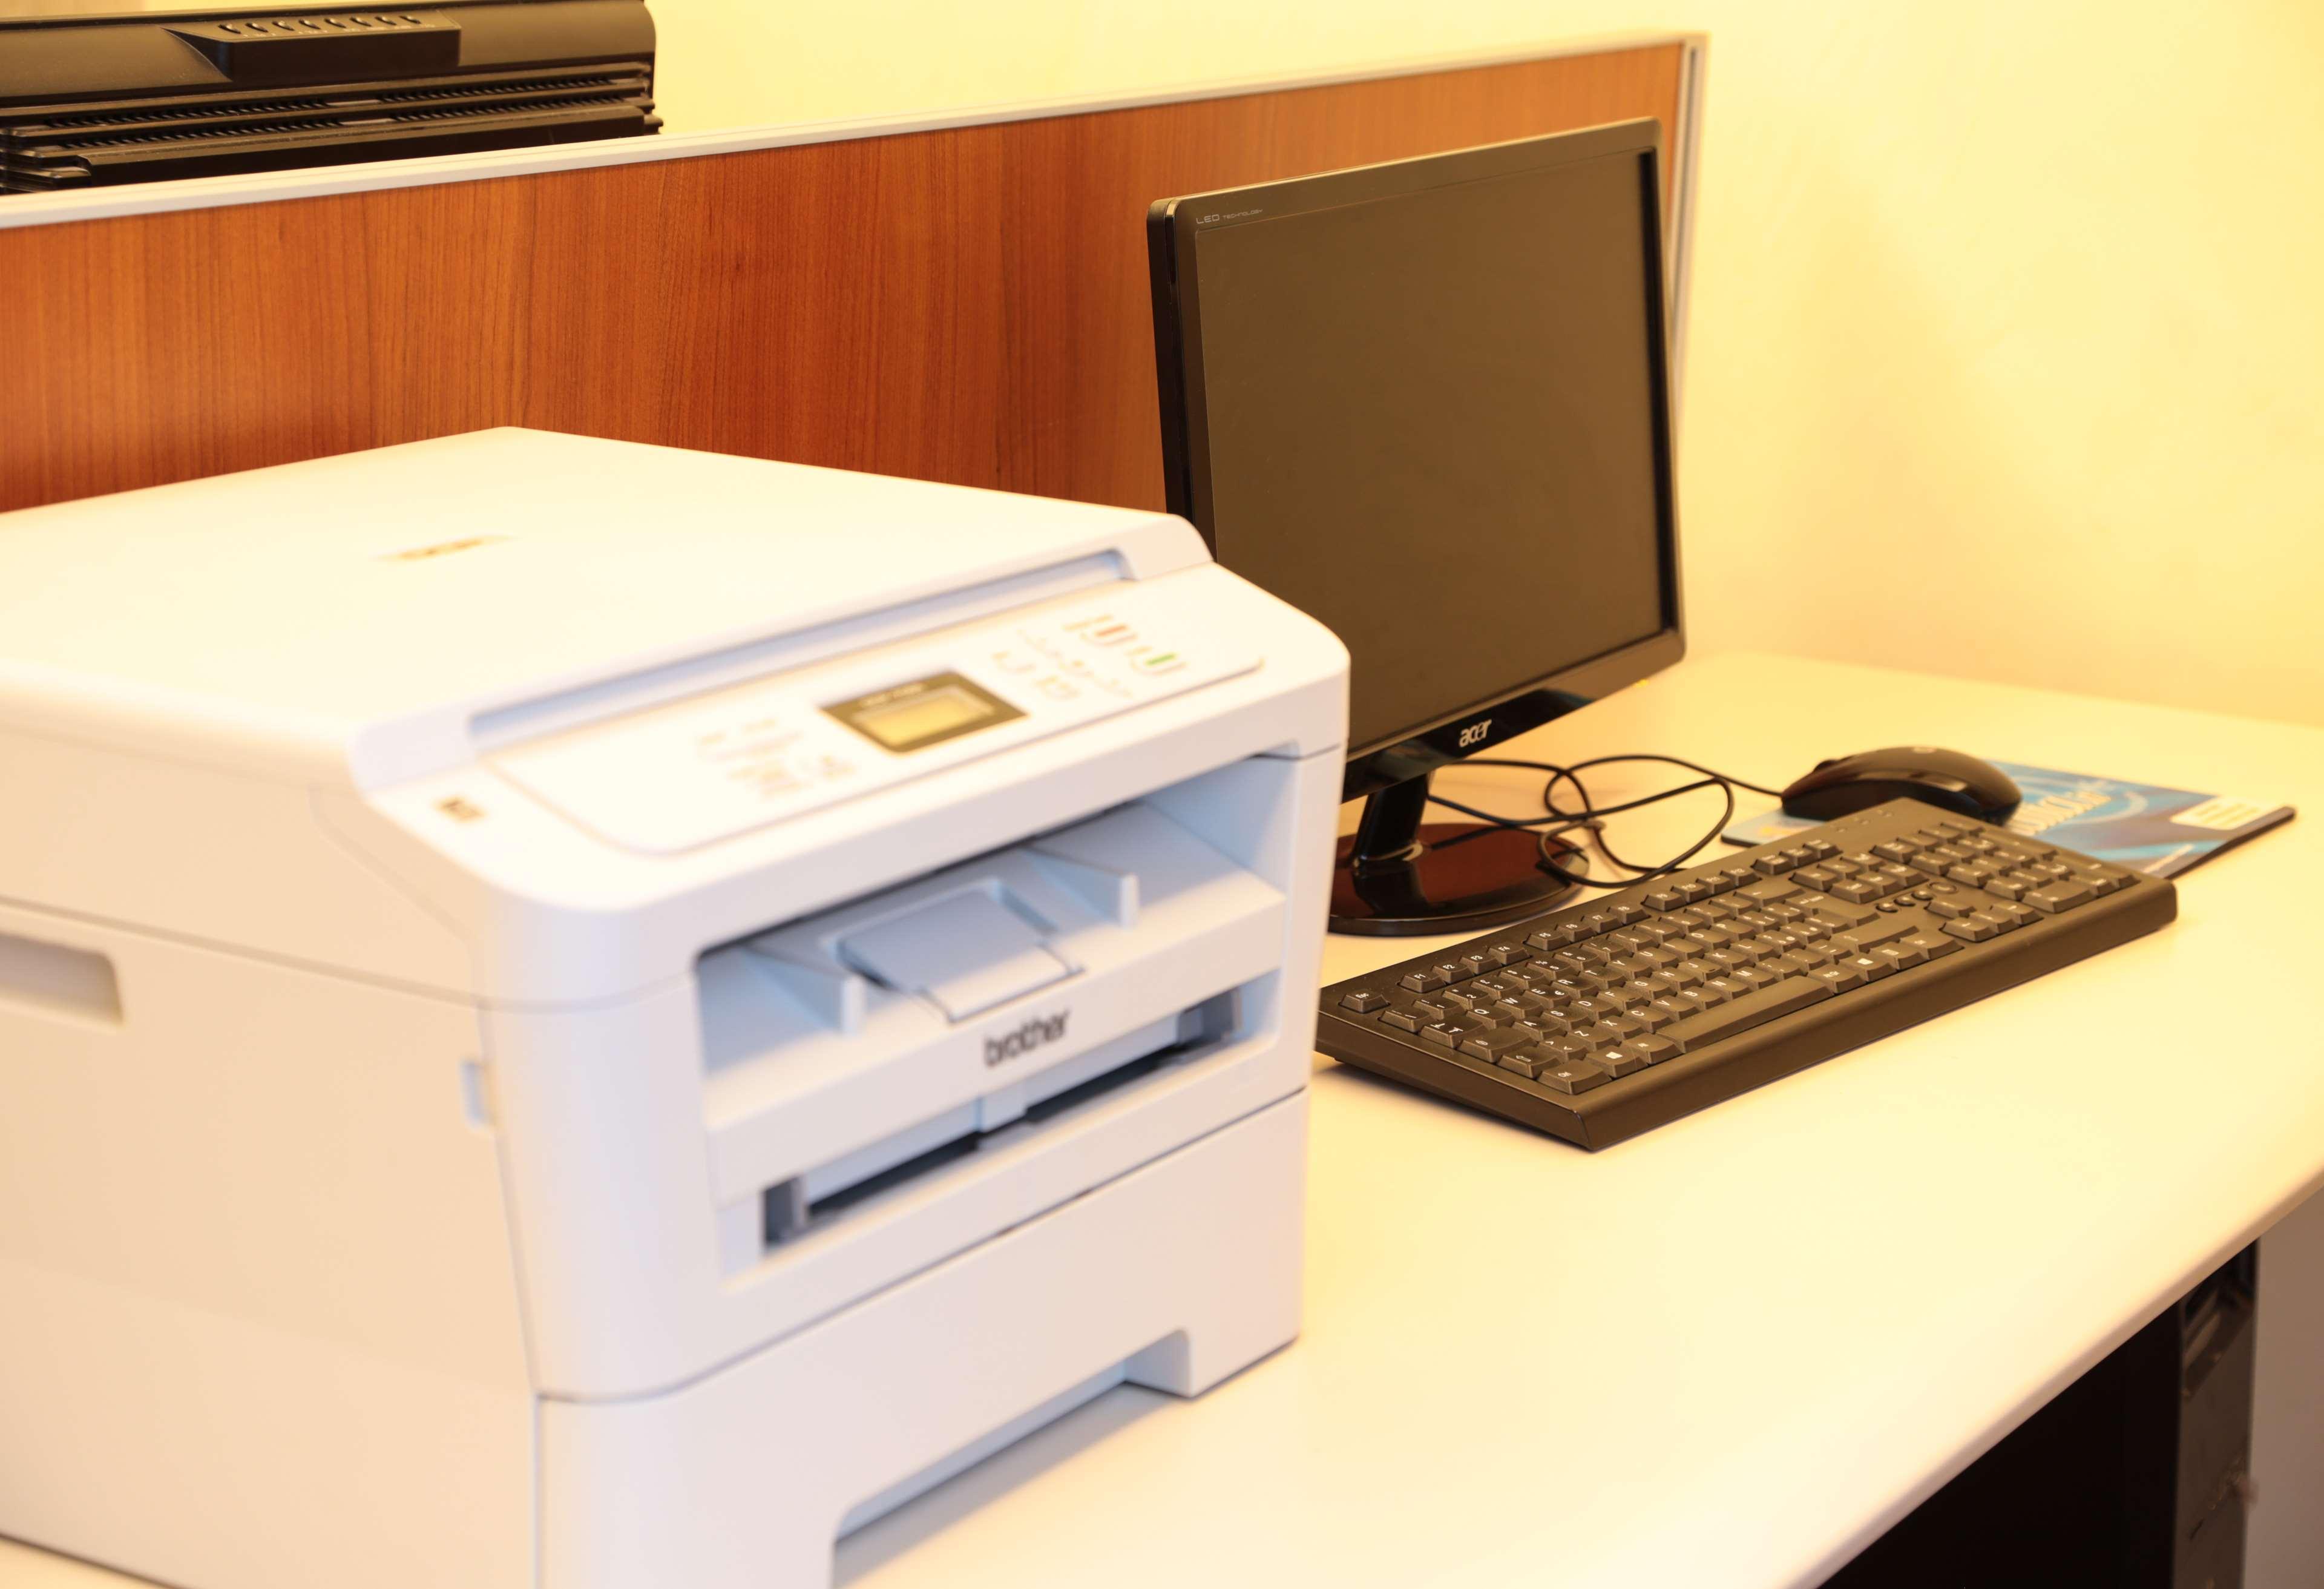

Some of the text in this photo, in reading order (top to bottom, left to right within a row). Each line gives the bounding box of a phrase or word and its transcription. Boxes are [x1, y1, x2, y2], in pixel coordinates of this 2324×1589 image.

[1196, 209, 1263, 224] LED TECHNOLOGY
[1459, 719, 1492, 747] acer
